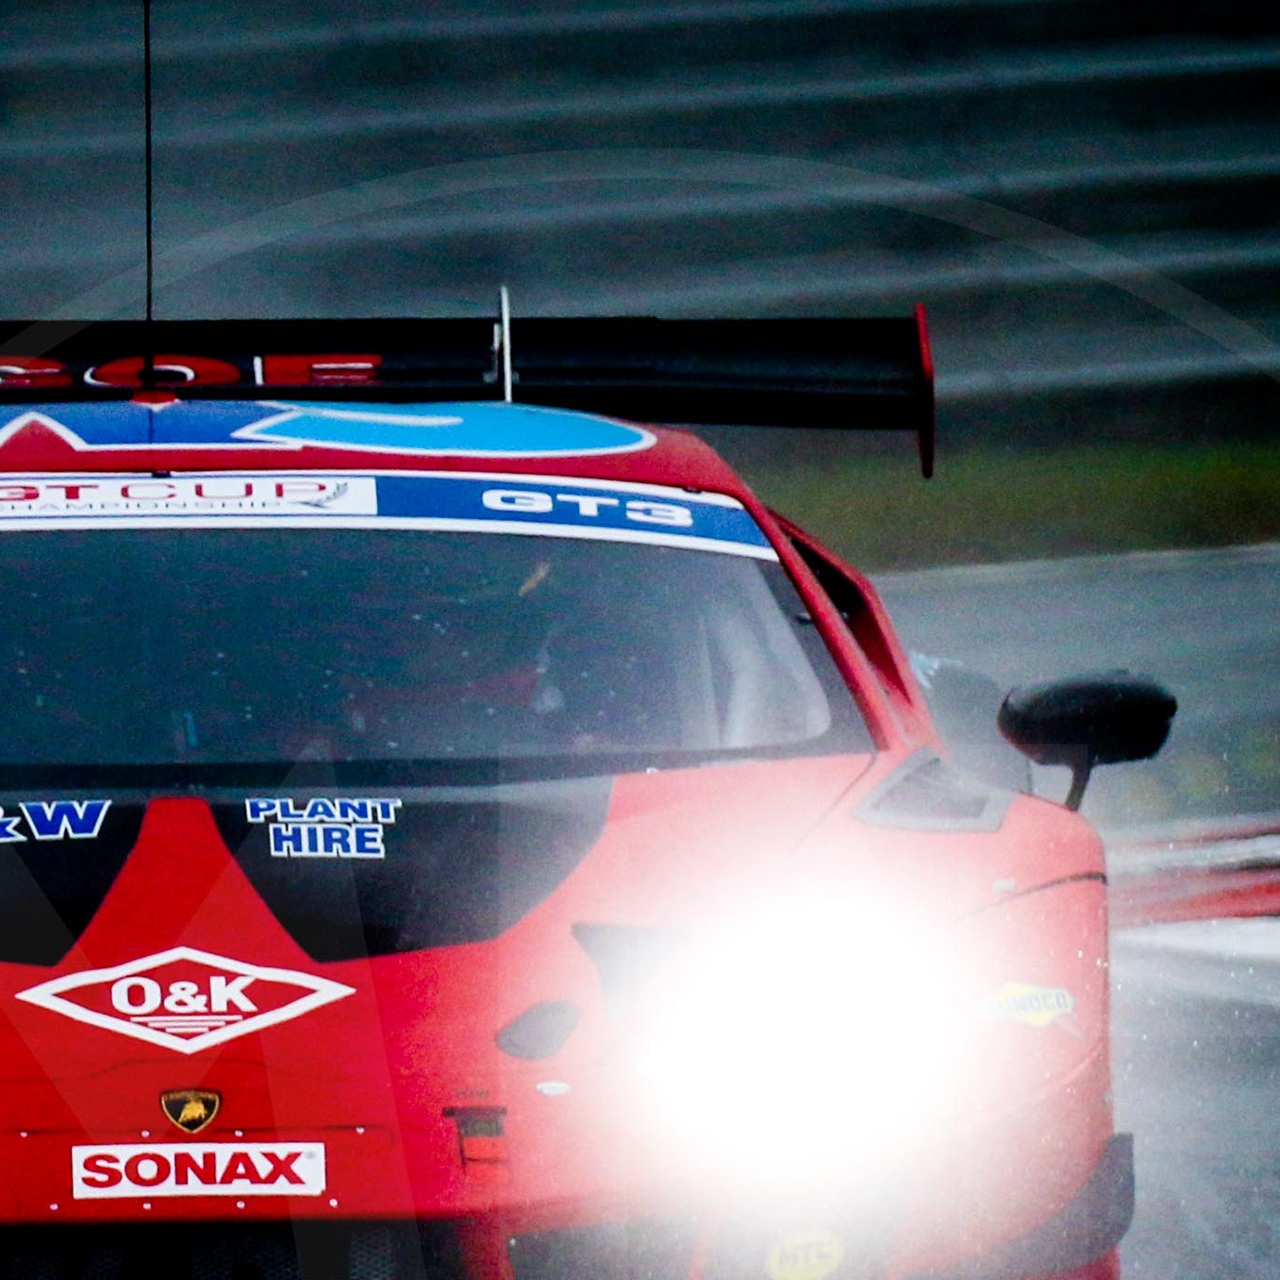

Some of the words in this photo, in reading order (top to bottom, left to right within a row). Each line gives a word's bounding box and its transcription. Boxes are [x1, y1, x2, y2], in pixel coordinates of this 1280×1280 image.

[120, 482, 327, 500] CUP
[483, 489, 694, 528] GT3
[246, 798, 402, 822] PLANT
[269, 822, 385, 858] HIRE
[110, 975, 259, 1016] O&K
[983, 990, 1068, 1017] UNOCO
[81, 1150, 306, 1188] SONAX
